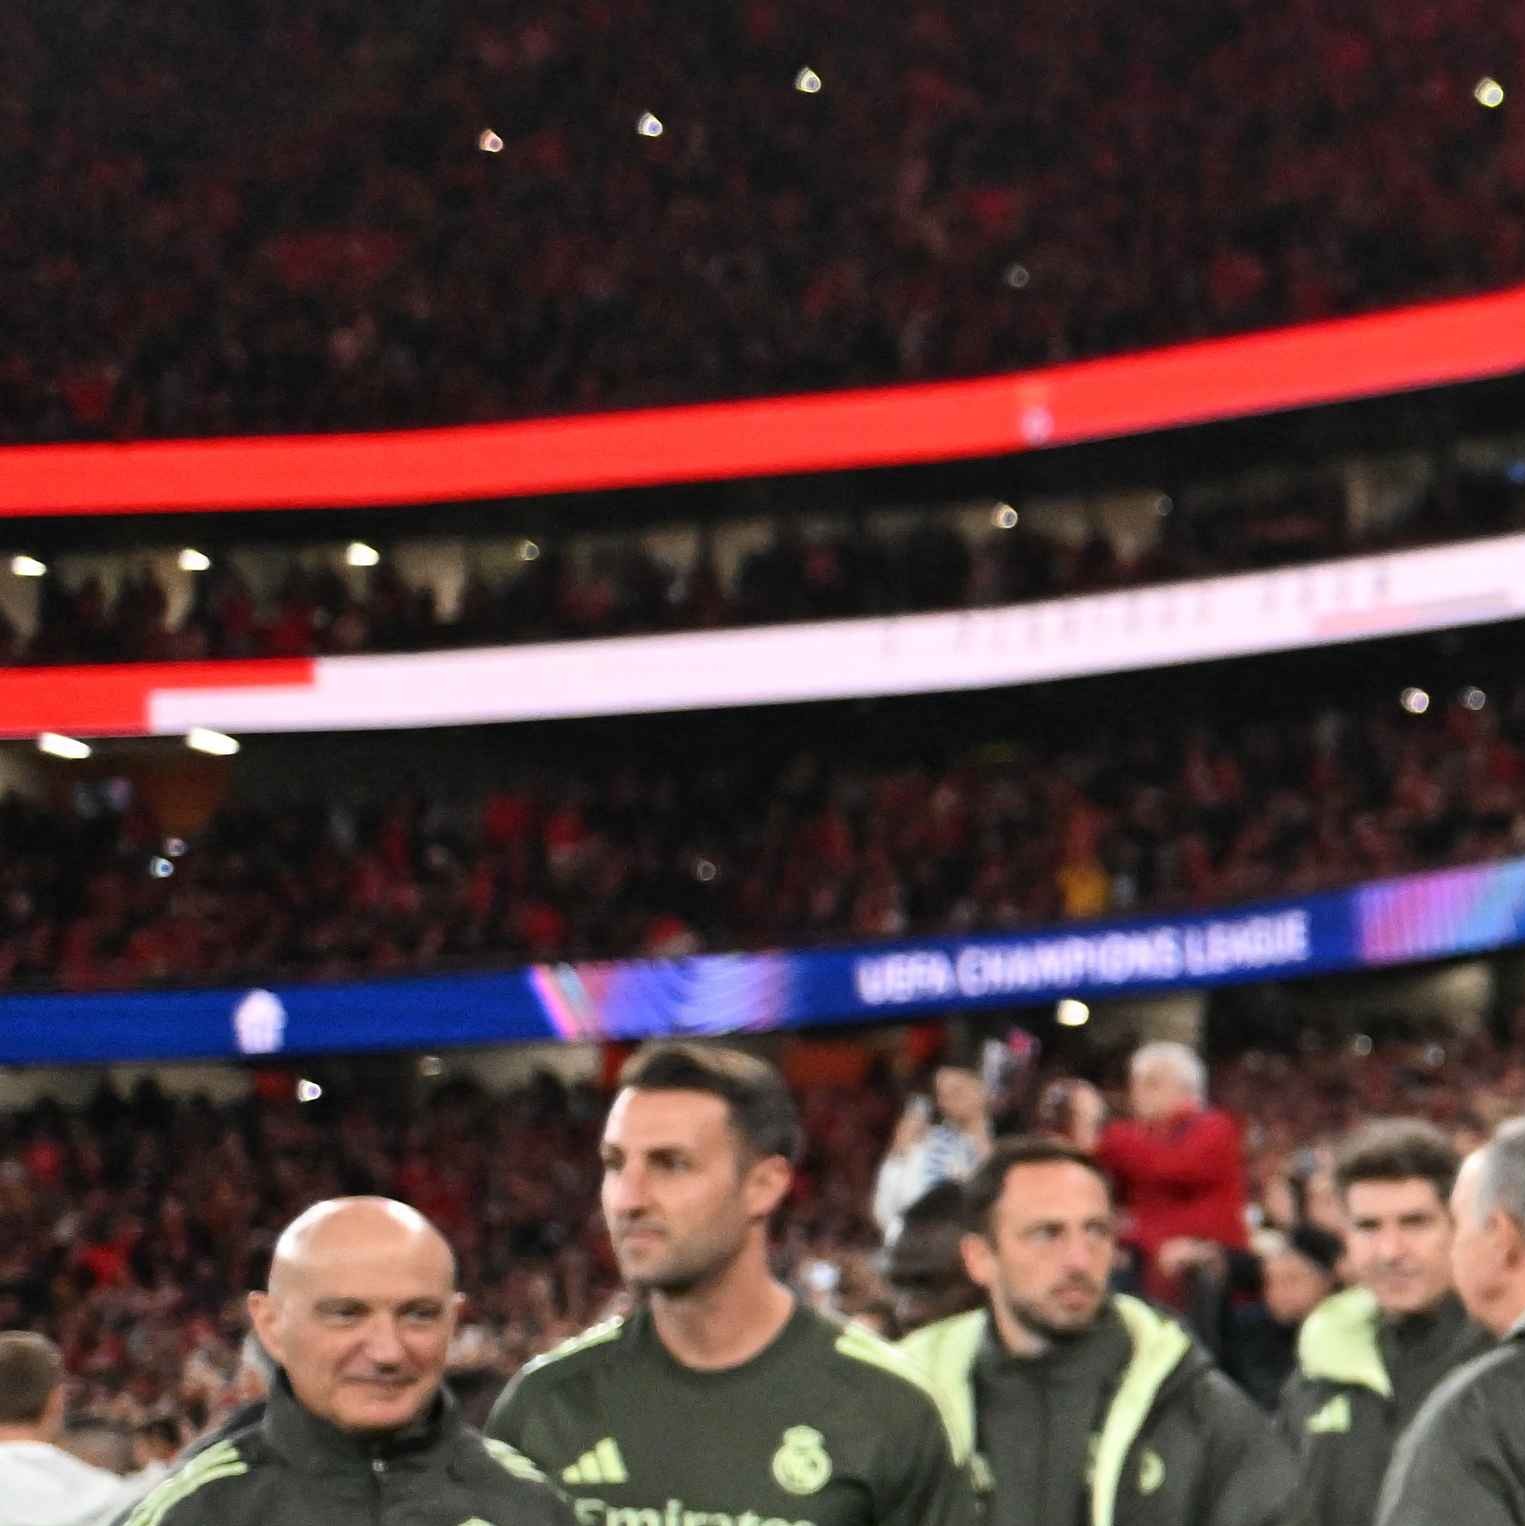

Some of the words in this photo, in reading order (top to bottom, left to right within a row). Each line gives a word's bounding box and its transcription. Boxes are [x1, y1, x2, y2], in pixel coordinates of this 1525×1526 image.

[857, 949, 955, 1006] UEFA
[956, 924, 1187, 998] CHAMPIONS
[1184, 908, 1310, 977] LEAGUE
